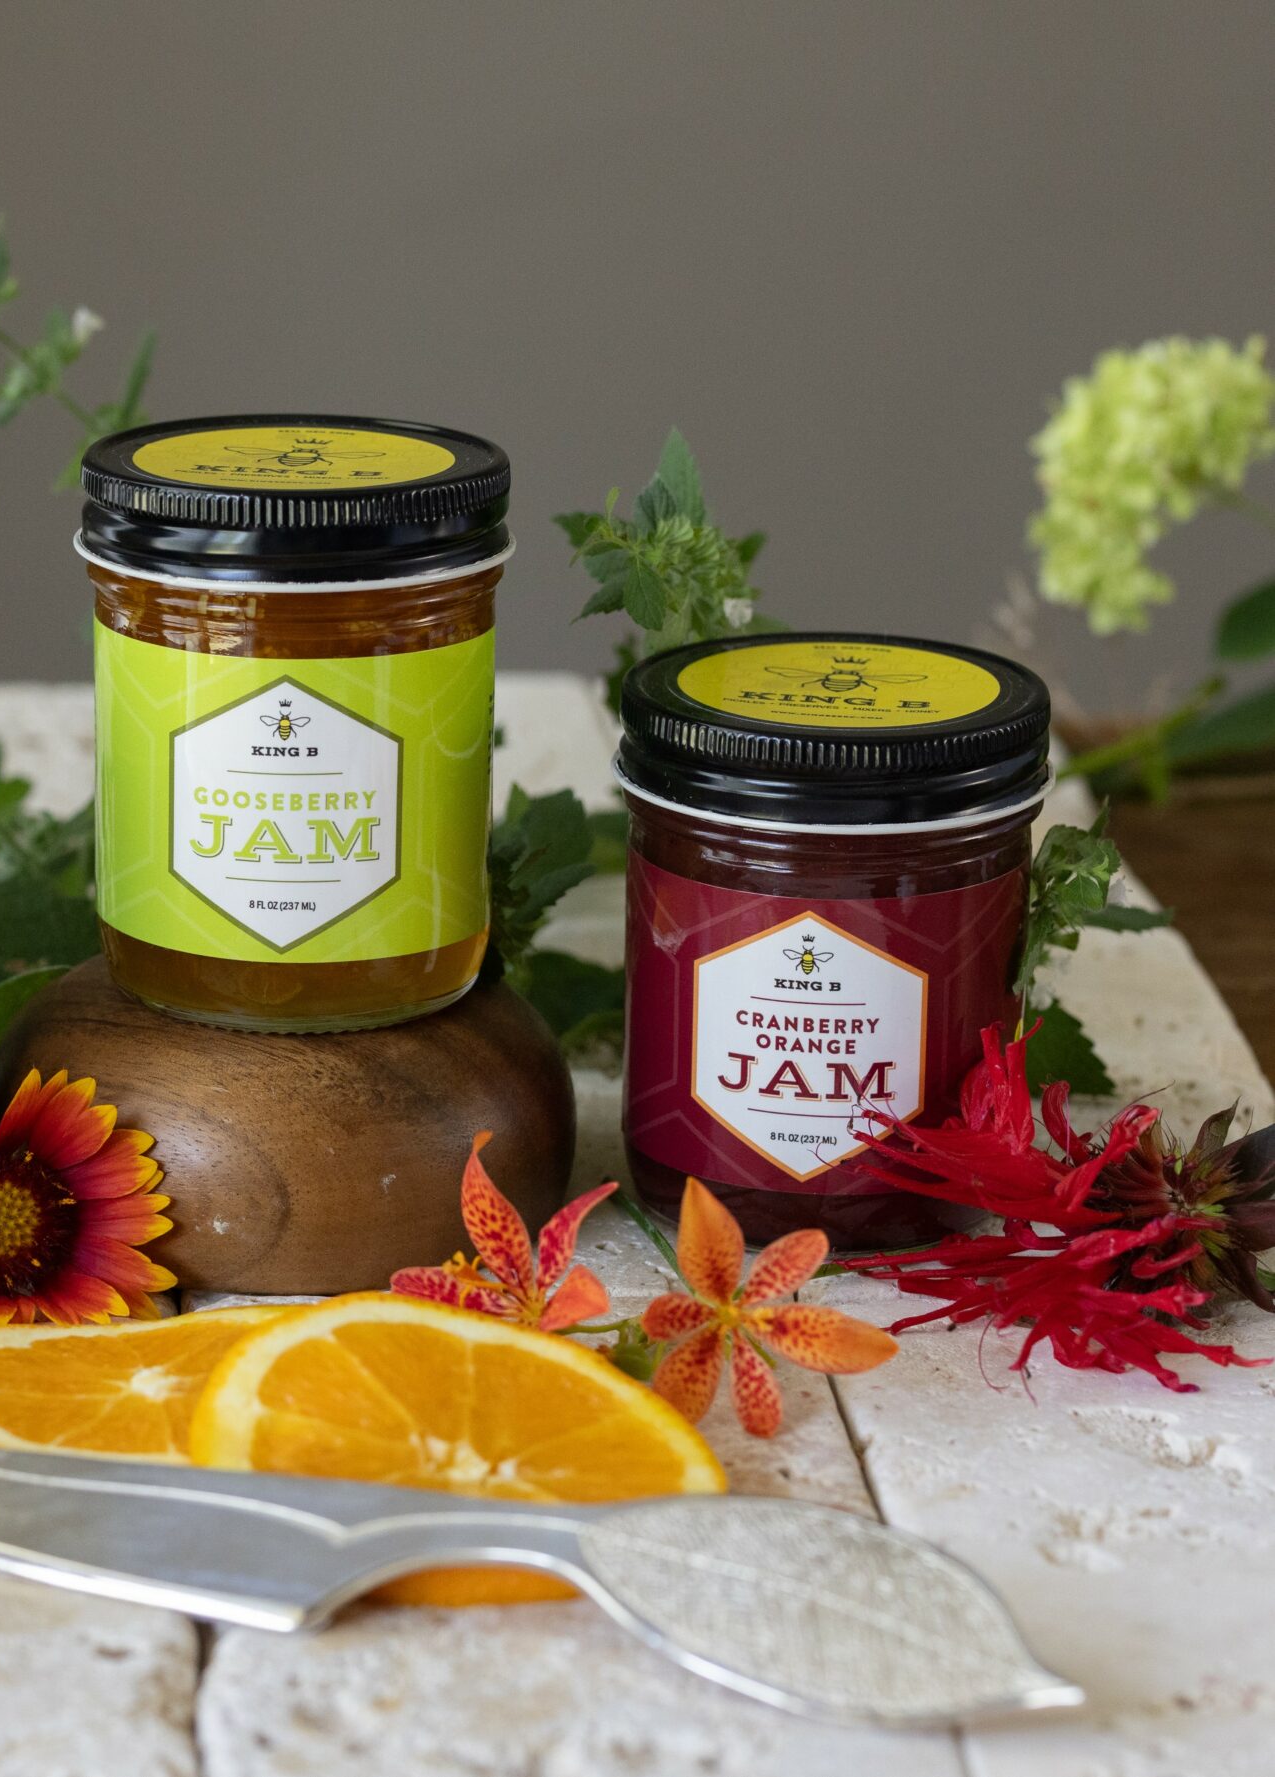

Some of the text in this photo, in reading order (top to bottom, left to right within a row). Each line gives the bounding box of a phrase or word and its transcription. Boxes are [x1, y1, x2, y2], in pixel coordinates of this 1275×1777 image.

[192, 464, 328, 475] KING
[739, 690, 931, 709] KING B
[779, 702, 840, 710] PRESERVES
[251, 745, 319, 758] KING B
[193, 786, 377, 812] GOOSEBERRY
[189, 812, 381, 864] JAM
[248, 900, 317, 912] 8 FL OZ (237 ML)
[774, 978, 842, 992] KING B
[736, 1010, 880, 1034] CRANBERRY
[756, 1034, 856, 1055] ORANGE
[717, 1051, 896, 1102] JAM
[770, 1132, 838, 1146] 8 FL OZ (237 ML)
